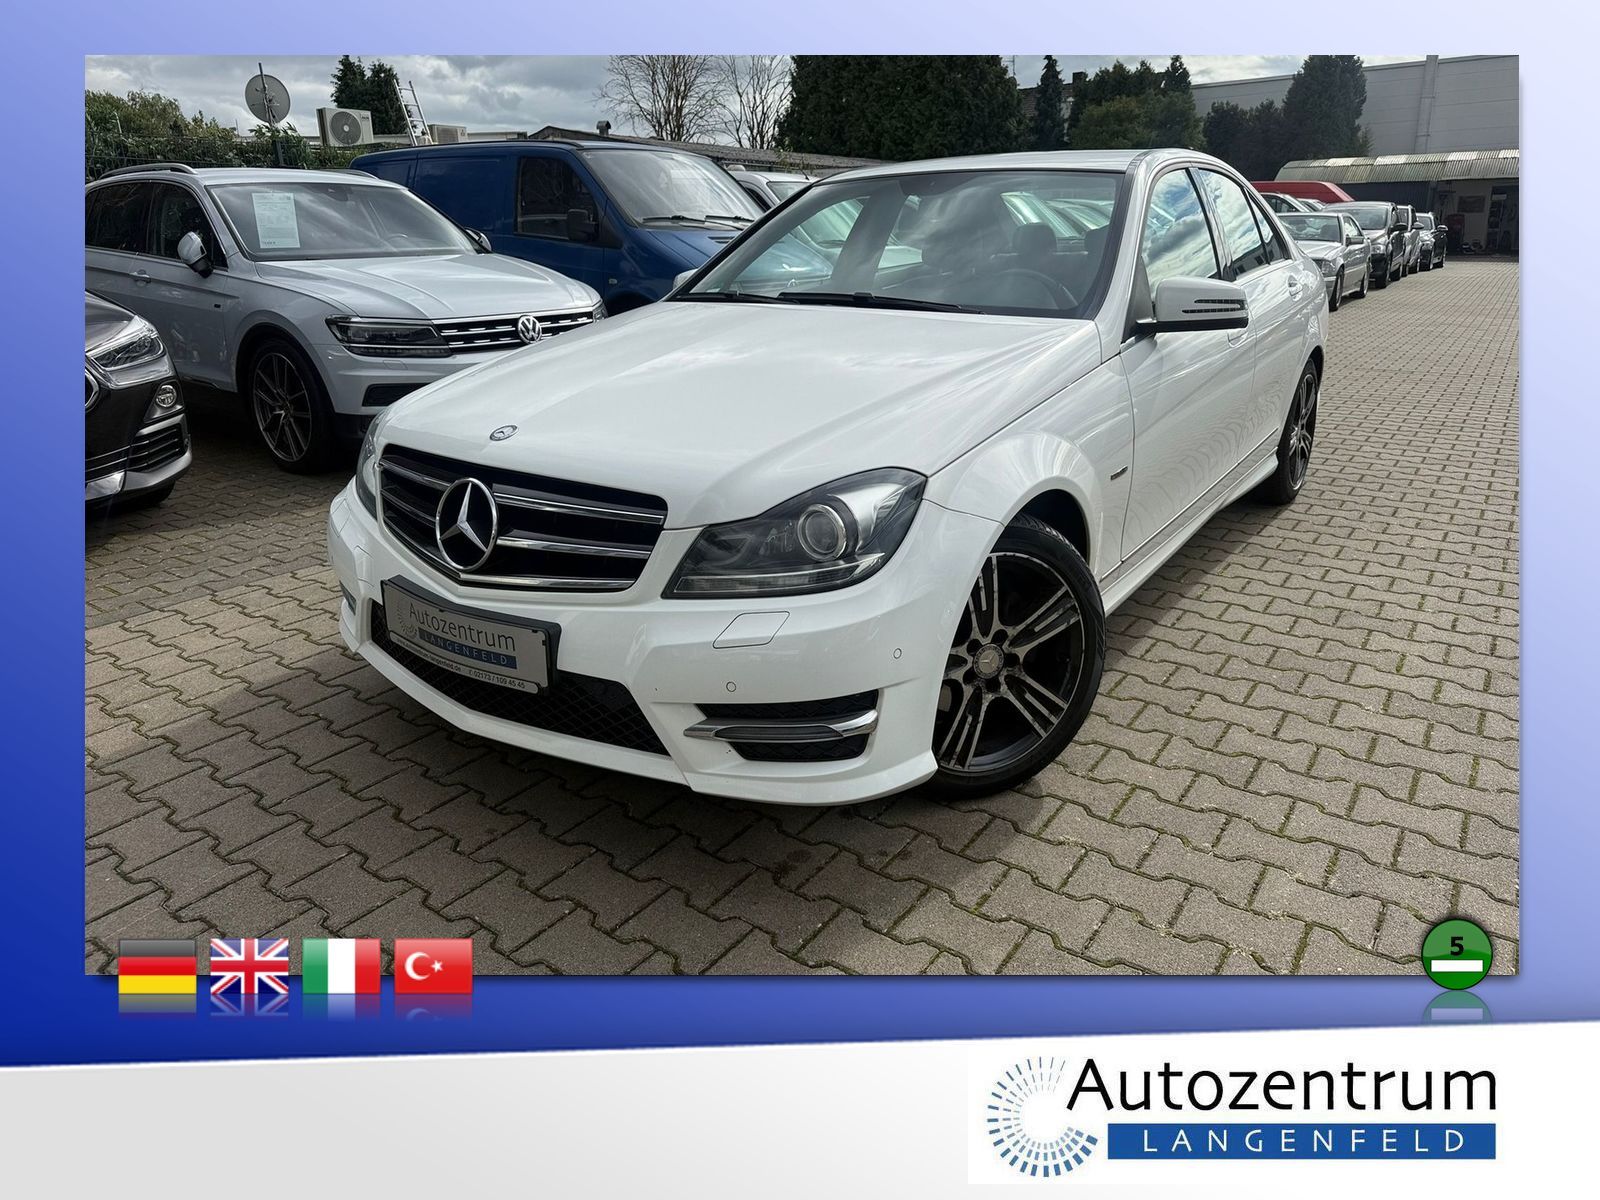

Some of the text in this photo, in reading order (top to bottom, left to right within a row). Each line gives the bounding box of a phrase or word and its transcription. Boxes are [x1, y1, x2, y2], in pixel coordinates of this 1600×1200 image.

[409, 603, 516, 651] Autozentrum
[424, 632, 508, 665] LANGENFELD
[473, 670, 492, 681] 02173
[496, 676, 508, 685] 109
